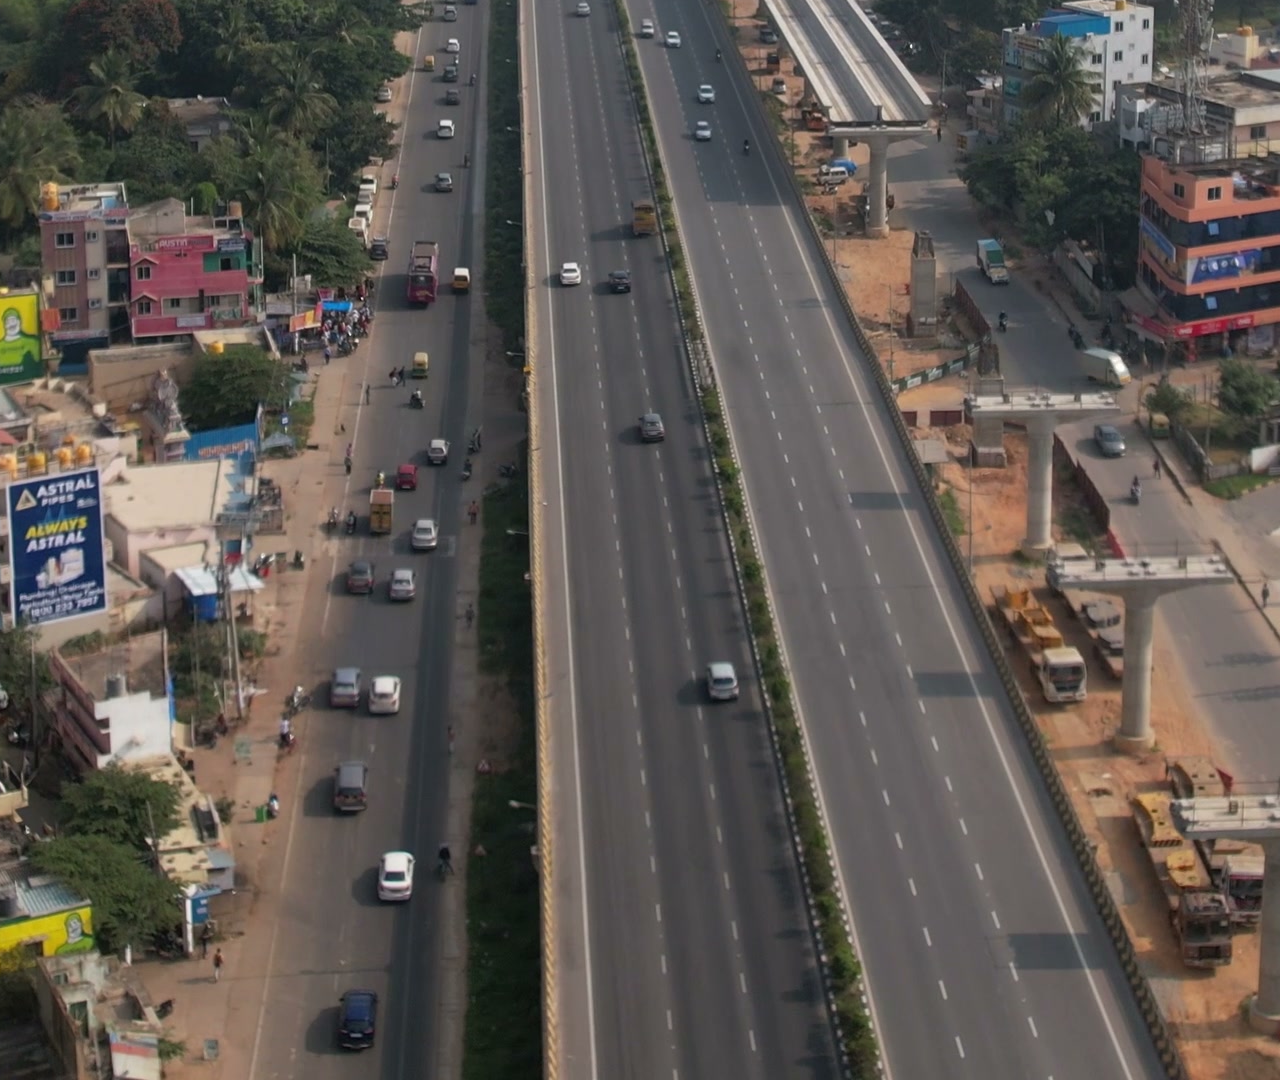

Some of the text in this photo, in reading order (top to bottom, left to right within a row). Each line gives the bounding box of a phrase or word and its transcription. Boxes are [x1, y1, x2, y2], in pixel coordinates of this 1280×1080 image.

[37, 474, 95, 497] ASTRAL
[41, 494, 74, 507] PIPES
[25, 516, 87, 539] ALWAYS
[26, 531, 85, 552] ASTRAL
